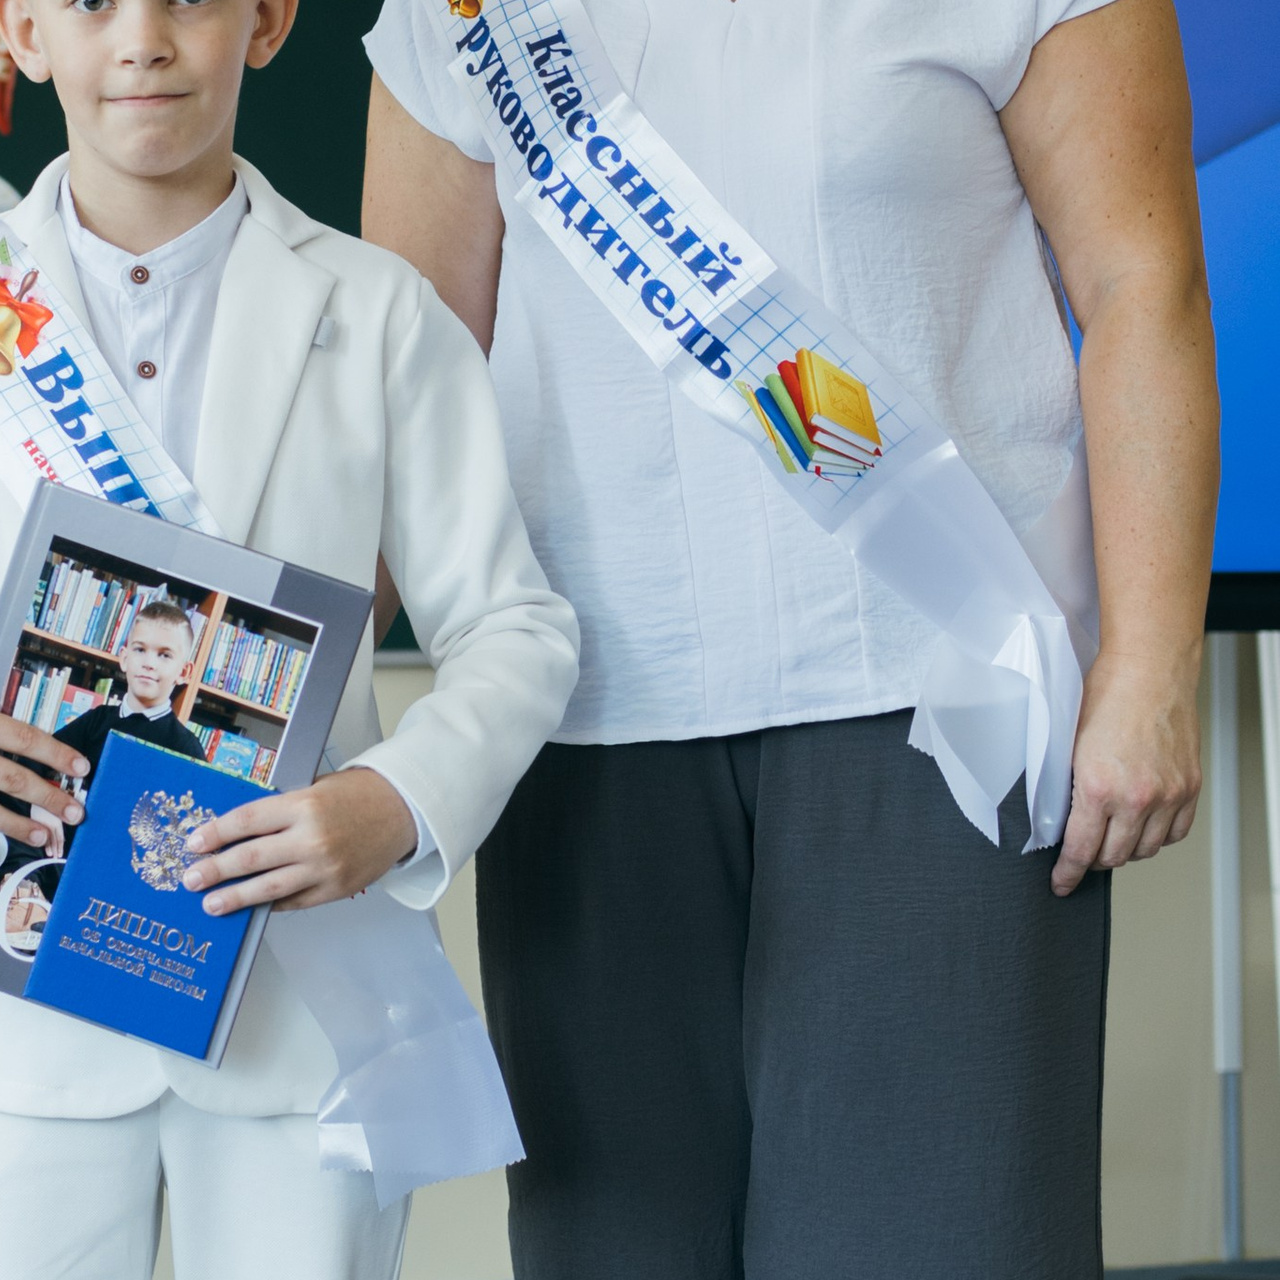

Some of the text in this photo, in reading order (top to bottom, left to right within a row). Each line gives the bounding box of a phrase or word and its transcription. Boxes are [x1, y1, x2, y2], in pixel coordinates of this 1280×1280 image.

[524, 29, 743, 297] Классный
[455, 15, 732, 380] руководитель
[20, 346, 166, 520] Вып
[21, 438, 62, 486] нач
[78, 897, 212, 963] ДИПЛОМ
[81, 927, 196, 980] ОБ ОКОНЧАНИИ
[58, 935, 207, 1001] НАЧАЛЬНОЙ ШКОЛЫ
